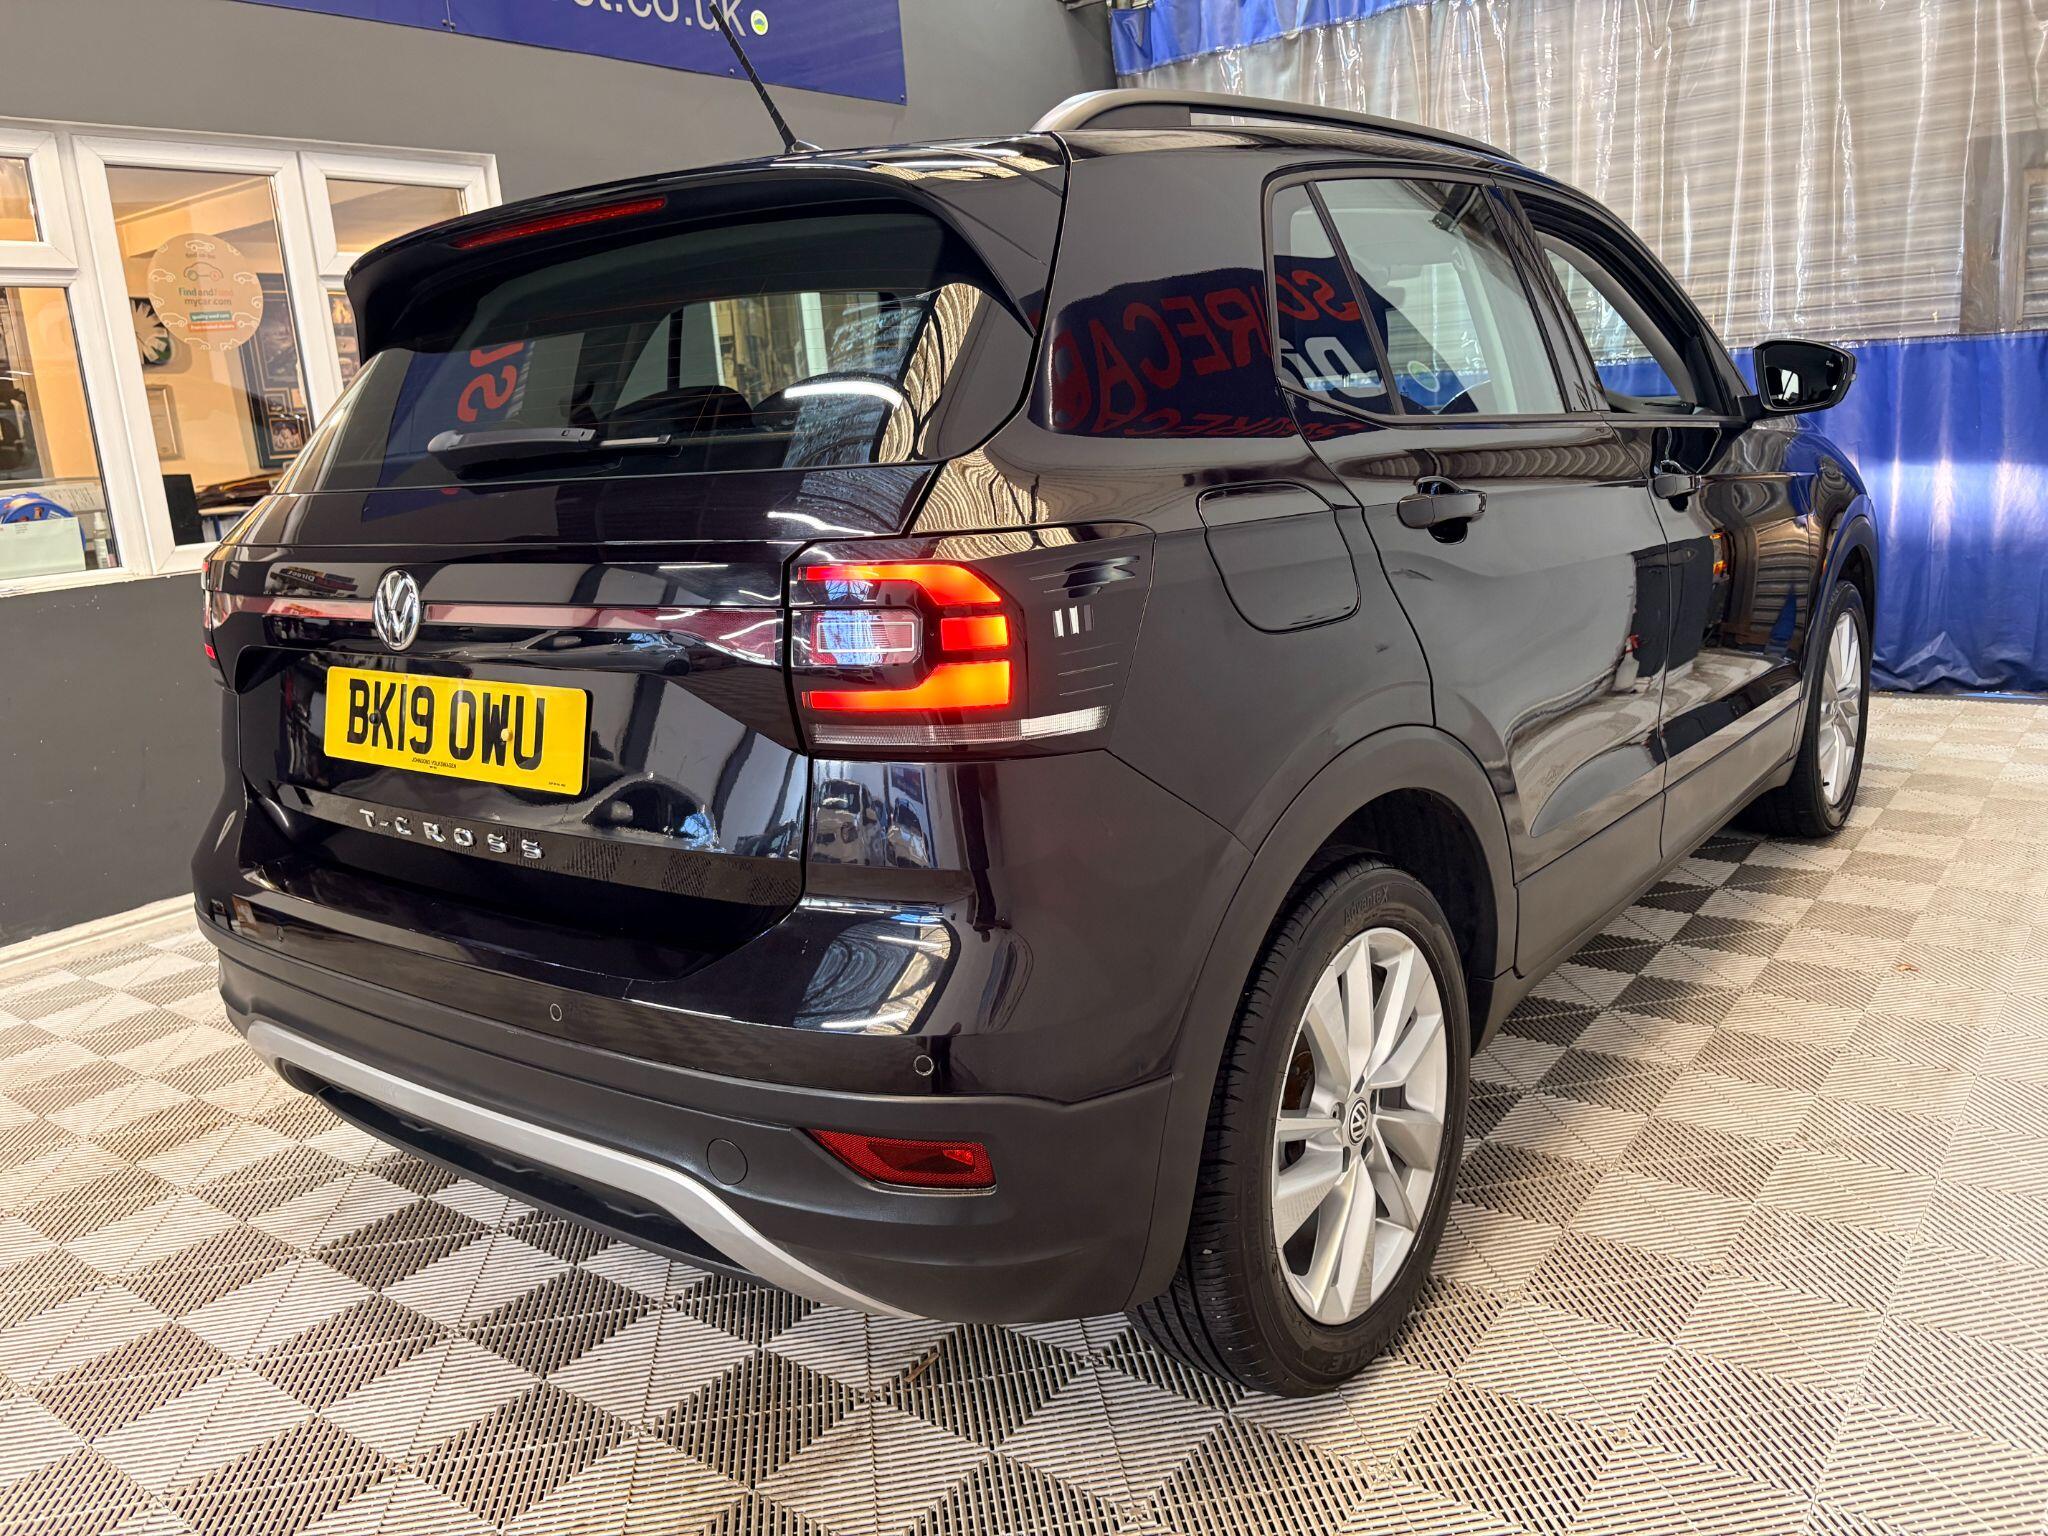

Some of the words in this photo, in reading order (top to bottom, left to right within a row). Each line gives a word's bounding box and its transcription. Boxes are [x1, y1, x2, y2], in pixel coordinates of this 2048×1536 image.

[184, 298, 232, 307] mycar.com
[347, 678, 435, 755] BK19
[449, 689, 546, 771] OWU
[359, 808, 544, 860] T-CROSS
